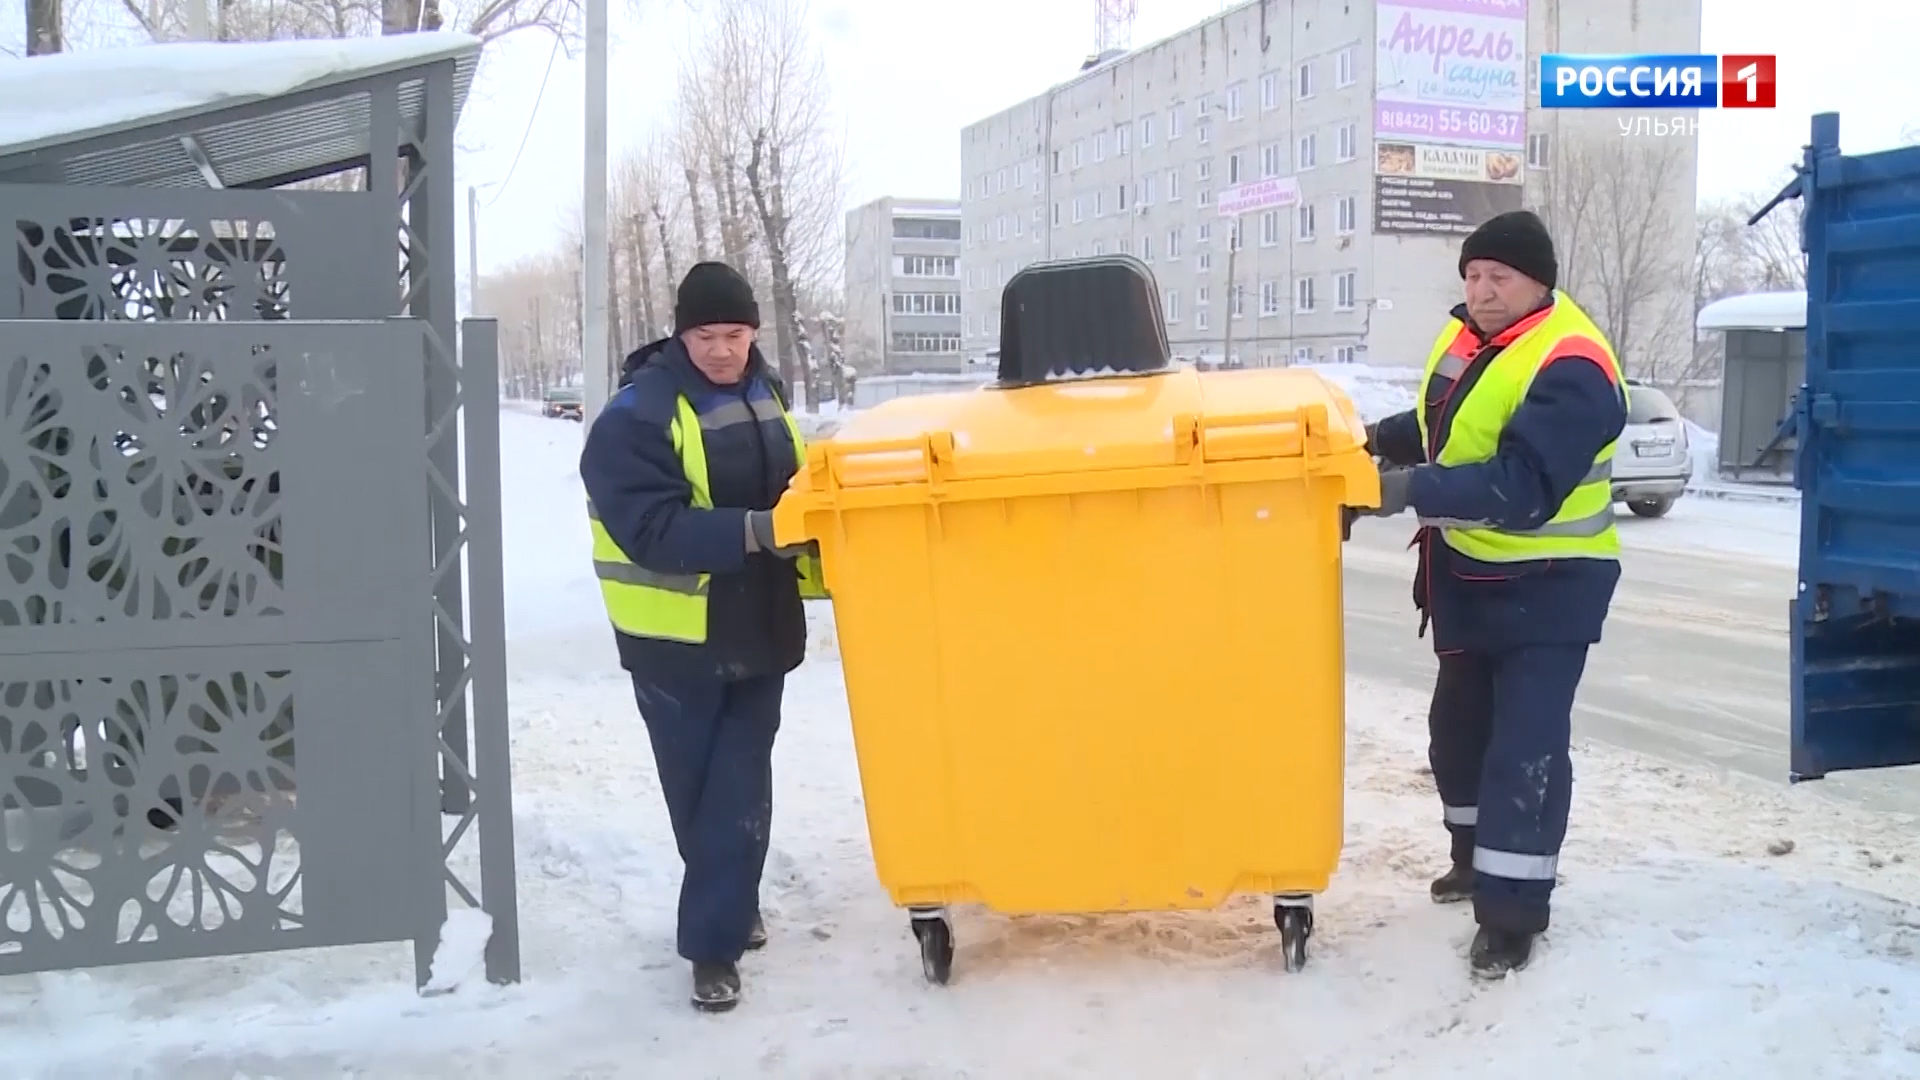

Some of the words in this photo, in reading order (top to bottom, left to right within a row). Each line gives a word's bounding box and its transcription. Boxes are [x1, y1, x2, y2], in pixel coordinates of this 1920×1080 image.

[1381, 109, 1434, 133] 8(8422)
[1438, 108, 1520, 136] 55-60-37
[1423, 150, 1479, 165] КАЛАЧИ
